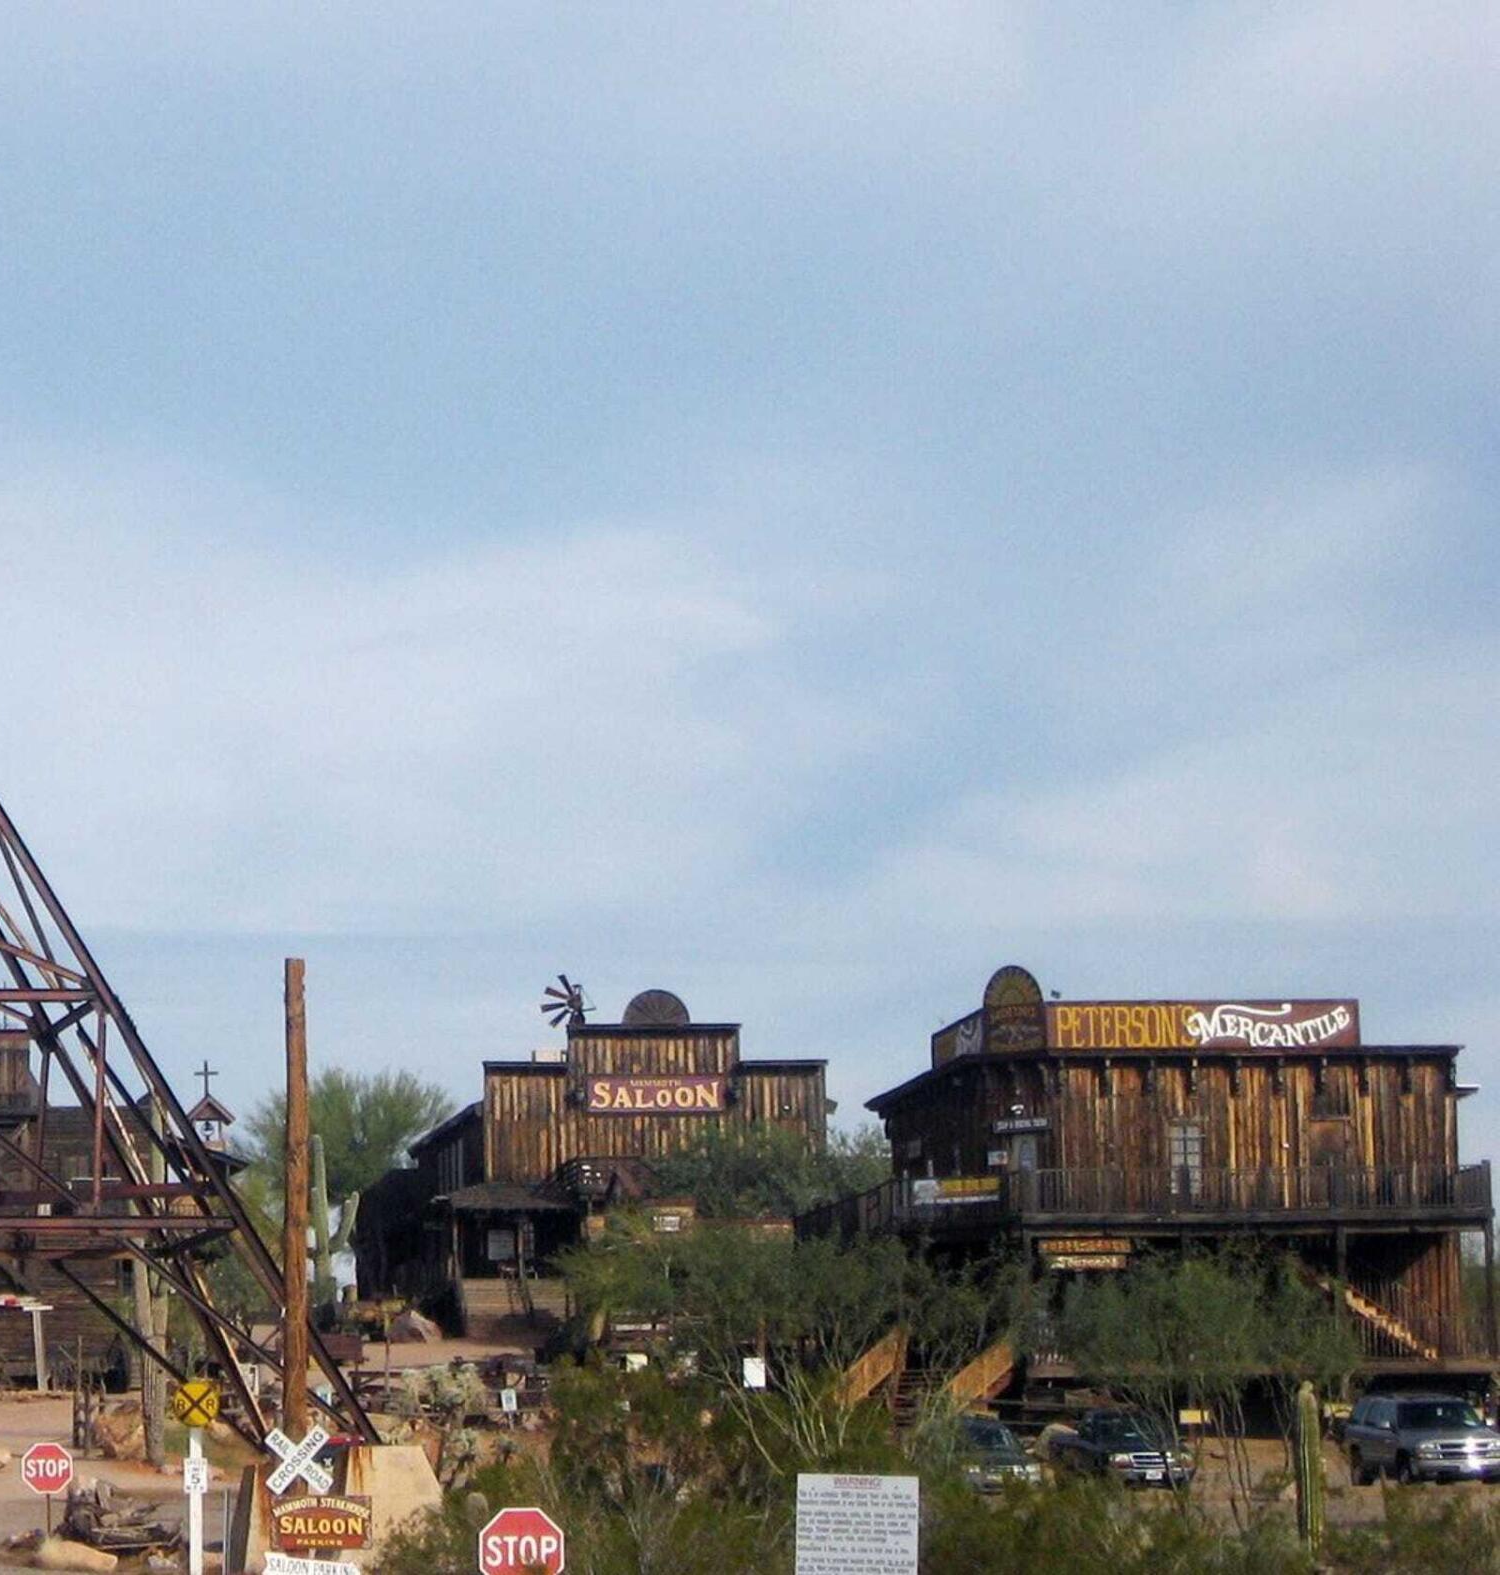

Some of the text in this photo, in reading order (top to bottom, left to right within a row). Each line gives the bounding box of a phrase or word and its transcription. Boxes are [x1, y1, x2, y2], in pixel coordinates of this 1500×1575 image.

[1056, 1003, 1350, 1048] PETERSON'S MERCANTILE
[590, 1081, 719, 1108] SALOON
[177, 1399, 215, 1411] R R
[26, 1458, 69, 1478] STOP
[271, 1430, 324, 1489] CROSSING
[190, 1473, 201, 1485] 5
[305, 1464, 329, 1489] ROAD
[272, 1497, 318, 1518] MAMMOTH
[280, 1516, 363, 1535] SALOON
[296, 1538, 343, 1546] PARKING
[485, 1535, 558, 1567] STOP
[269, 1557, 309, 1574] SALOON
